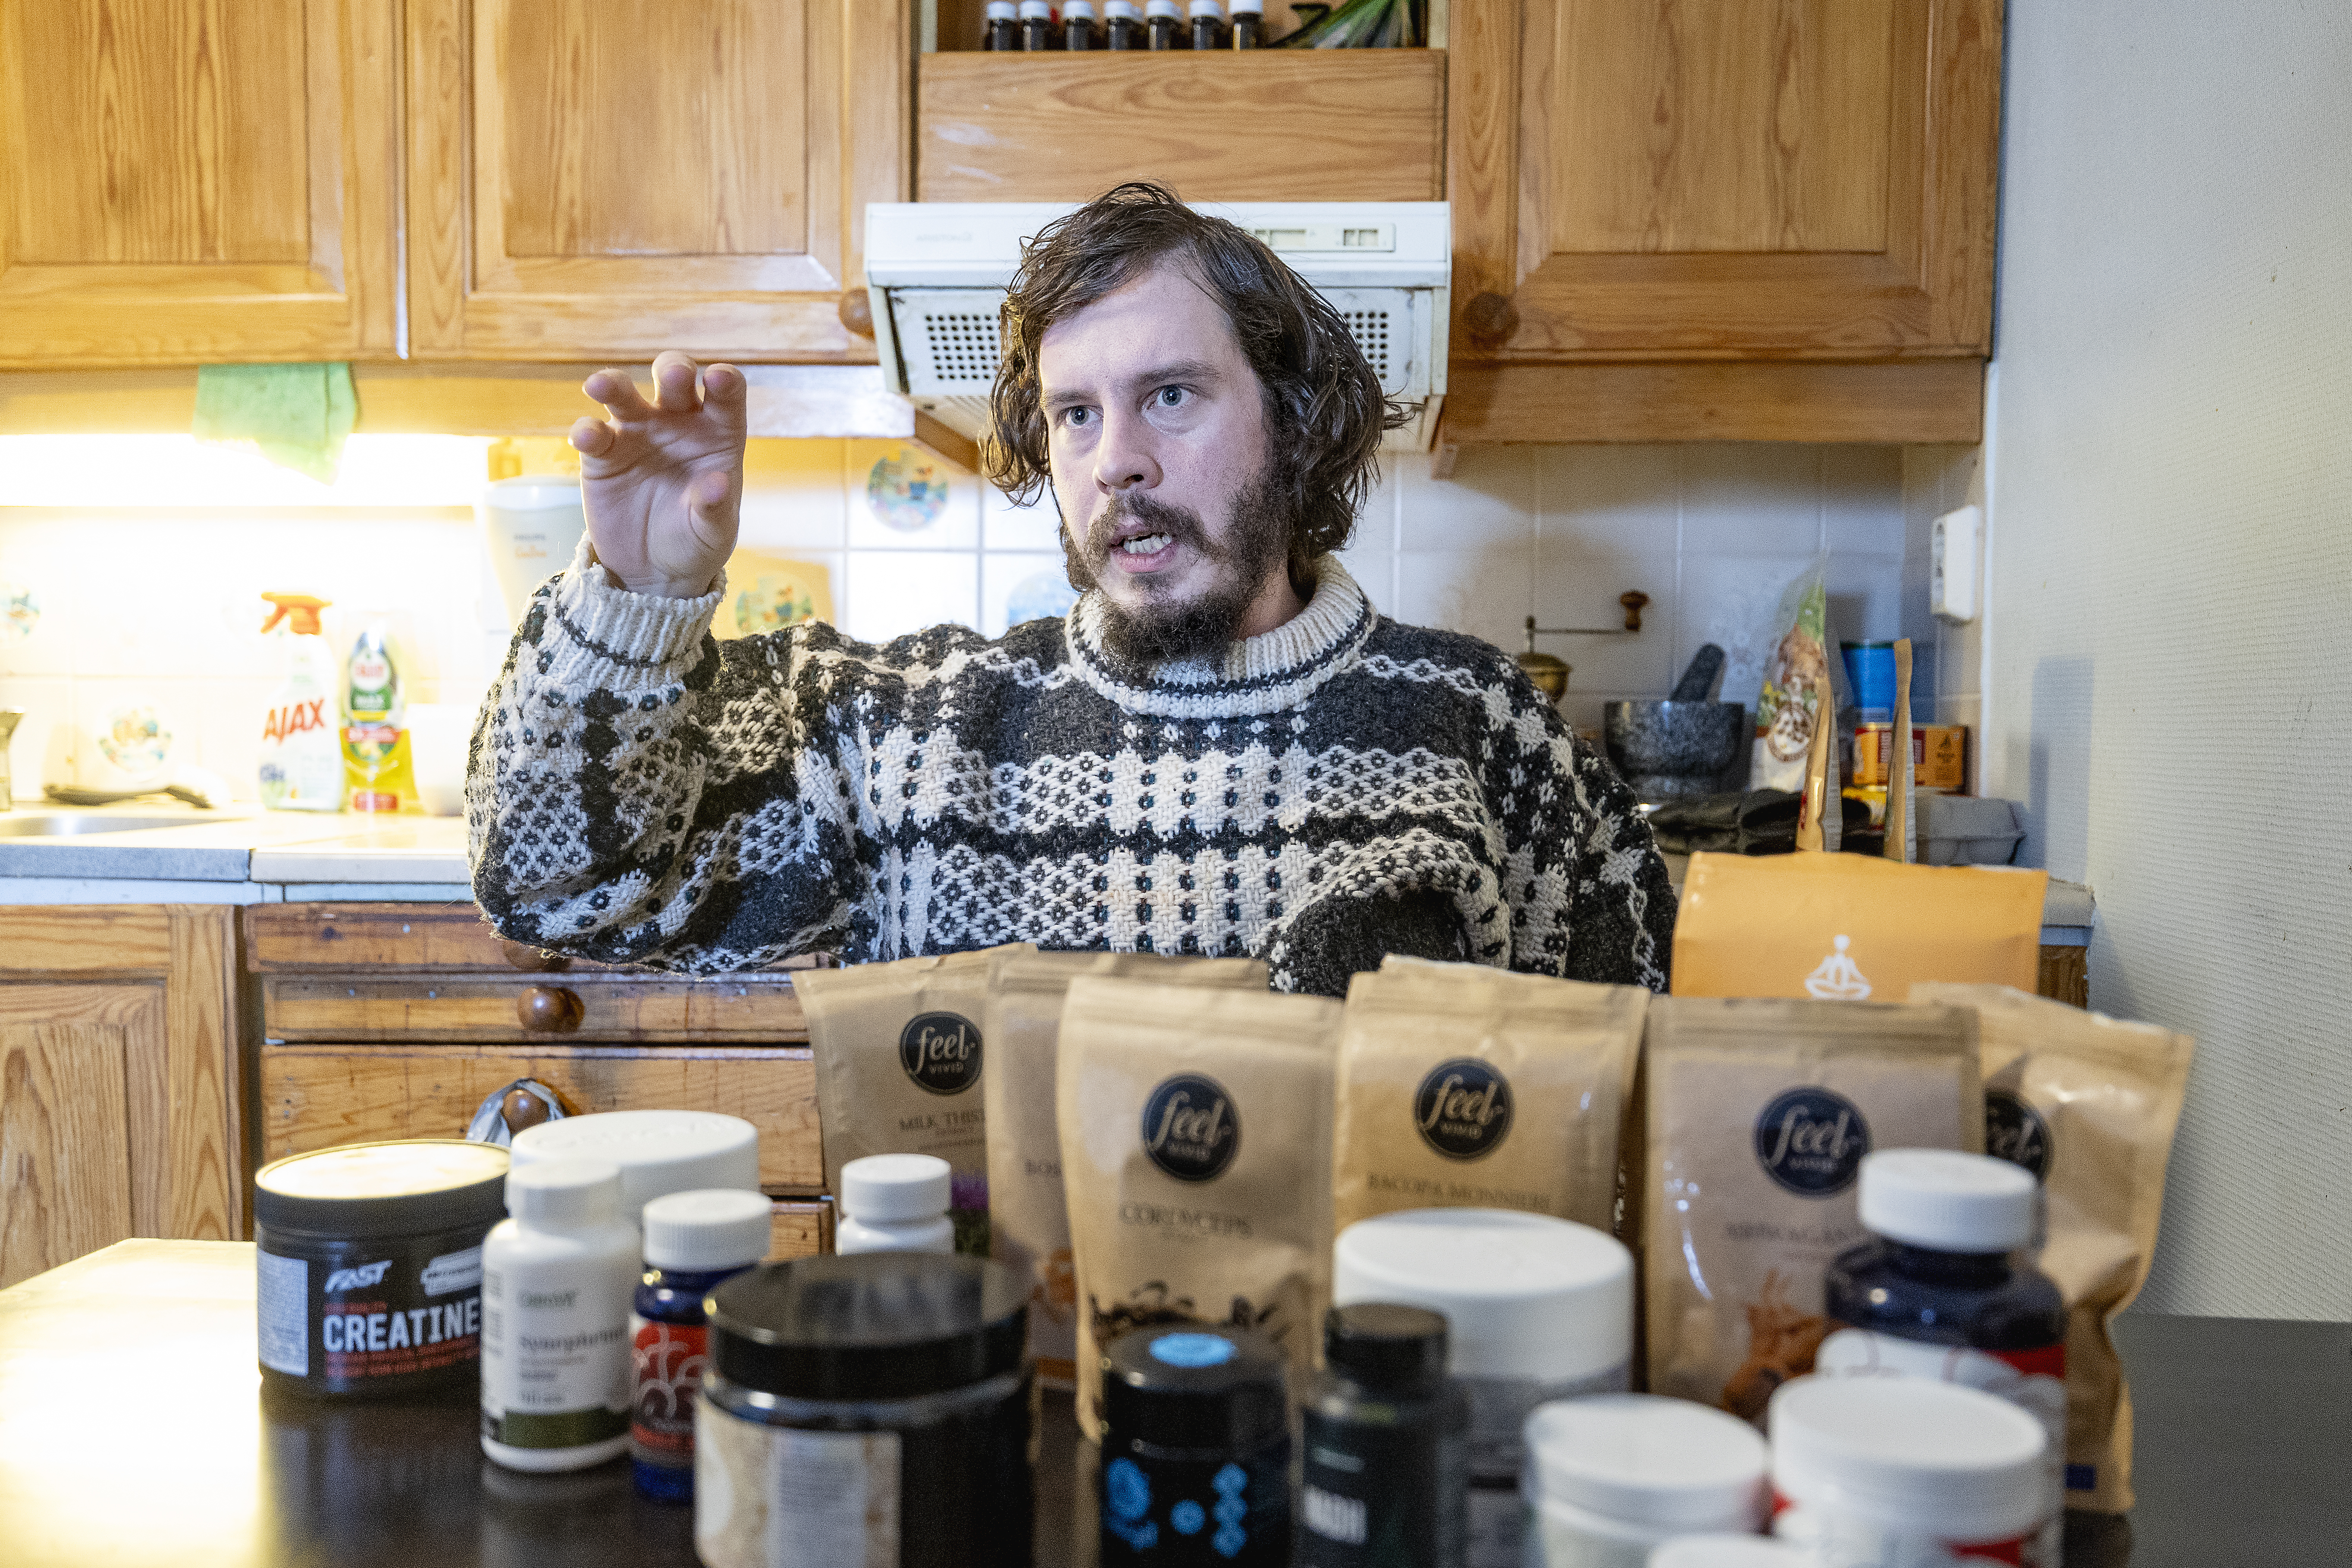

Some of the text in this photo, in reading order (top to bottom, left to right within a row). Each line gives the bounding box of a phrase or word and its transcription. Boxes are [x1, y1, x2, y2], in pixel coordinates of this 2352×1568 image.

[263, 697, 325, 746] AJAX
[906, 1024, 975, 1075] feel
[1145, 1090, 1231, 1151] feel
[1417, 1073, 1504, 1130] feel
[1765, 1104, 1862, 1167] feel
[324, 1260, 392, 1294] FAST
[323, 1297, 480, 1353] CREATINE
